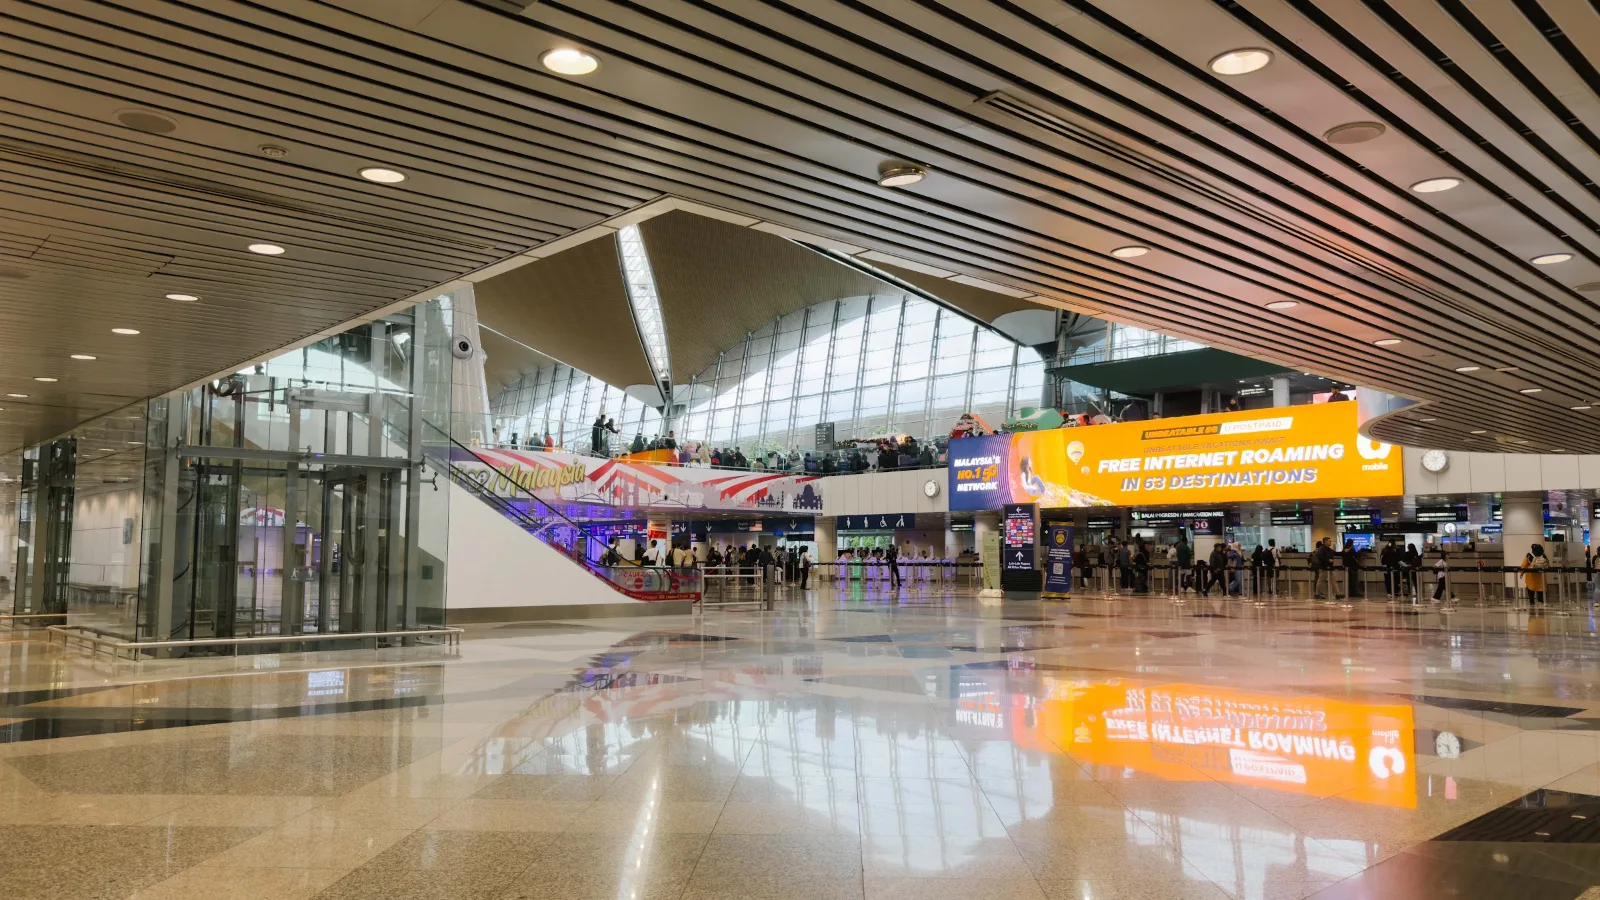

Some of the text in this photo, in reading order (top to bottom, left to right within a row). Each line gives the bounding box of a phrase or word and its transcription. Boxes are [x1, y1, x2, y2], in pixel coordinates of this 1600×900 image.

[1233, 421, 1282, 431] POSTPAID
[1143, 437, 1285, 454] UNBEATABLE VACATIONS AWAIT
[954, 455, 1001, 467] MALAYSIA'S
[1097, 443, 1345, 473] FREE INTERNET ROAMING
[1362, 462, 1389, 471] mobile
[488, 457, 586, 498] Malaysia
[957, 467, 981, 480] NO.1
[1120, 467, 1318, 492] IN 63 DESTINATIONS
[957, 481, 998, 492] NETWORK
